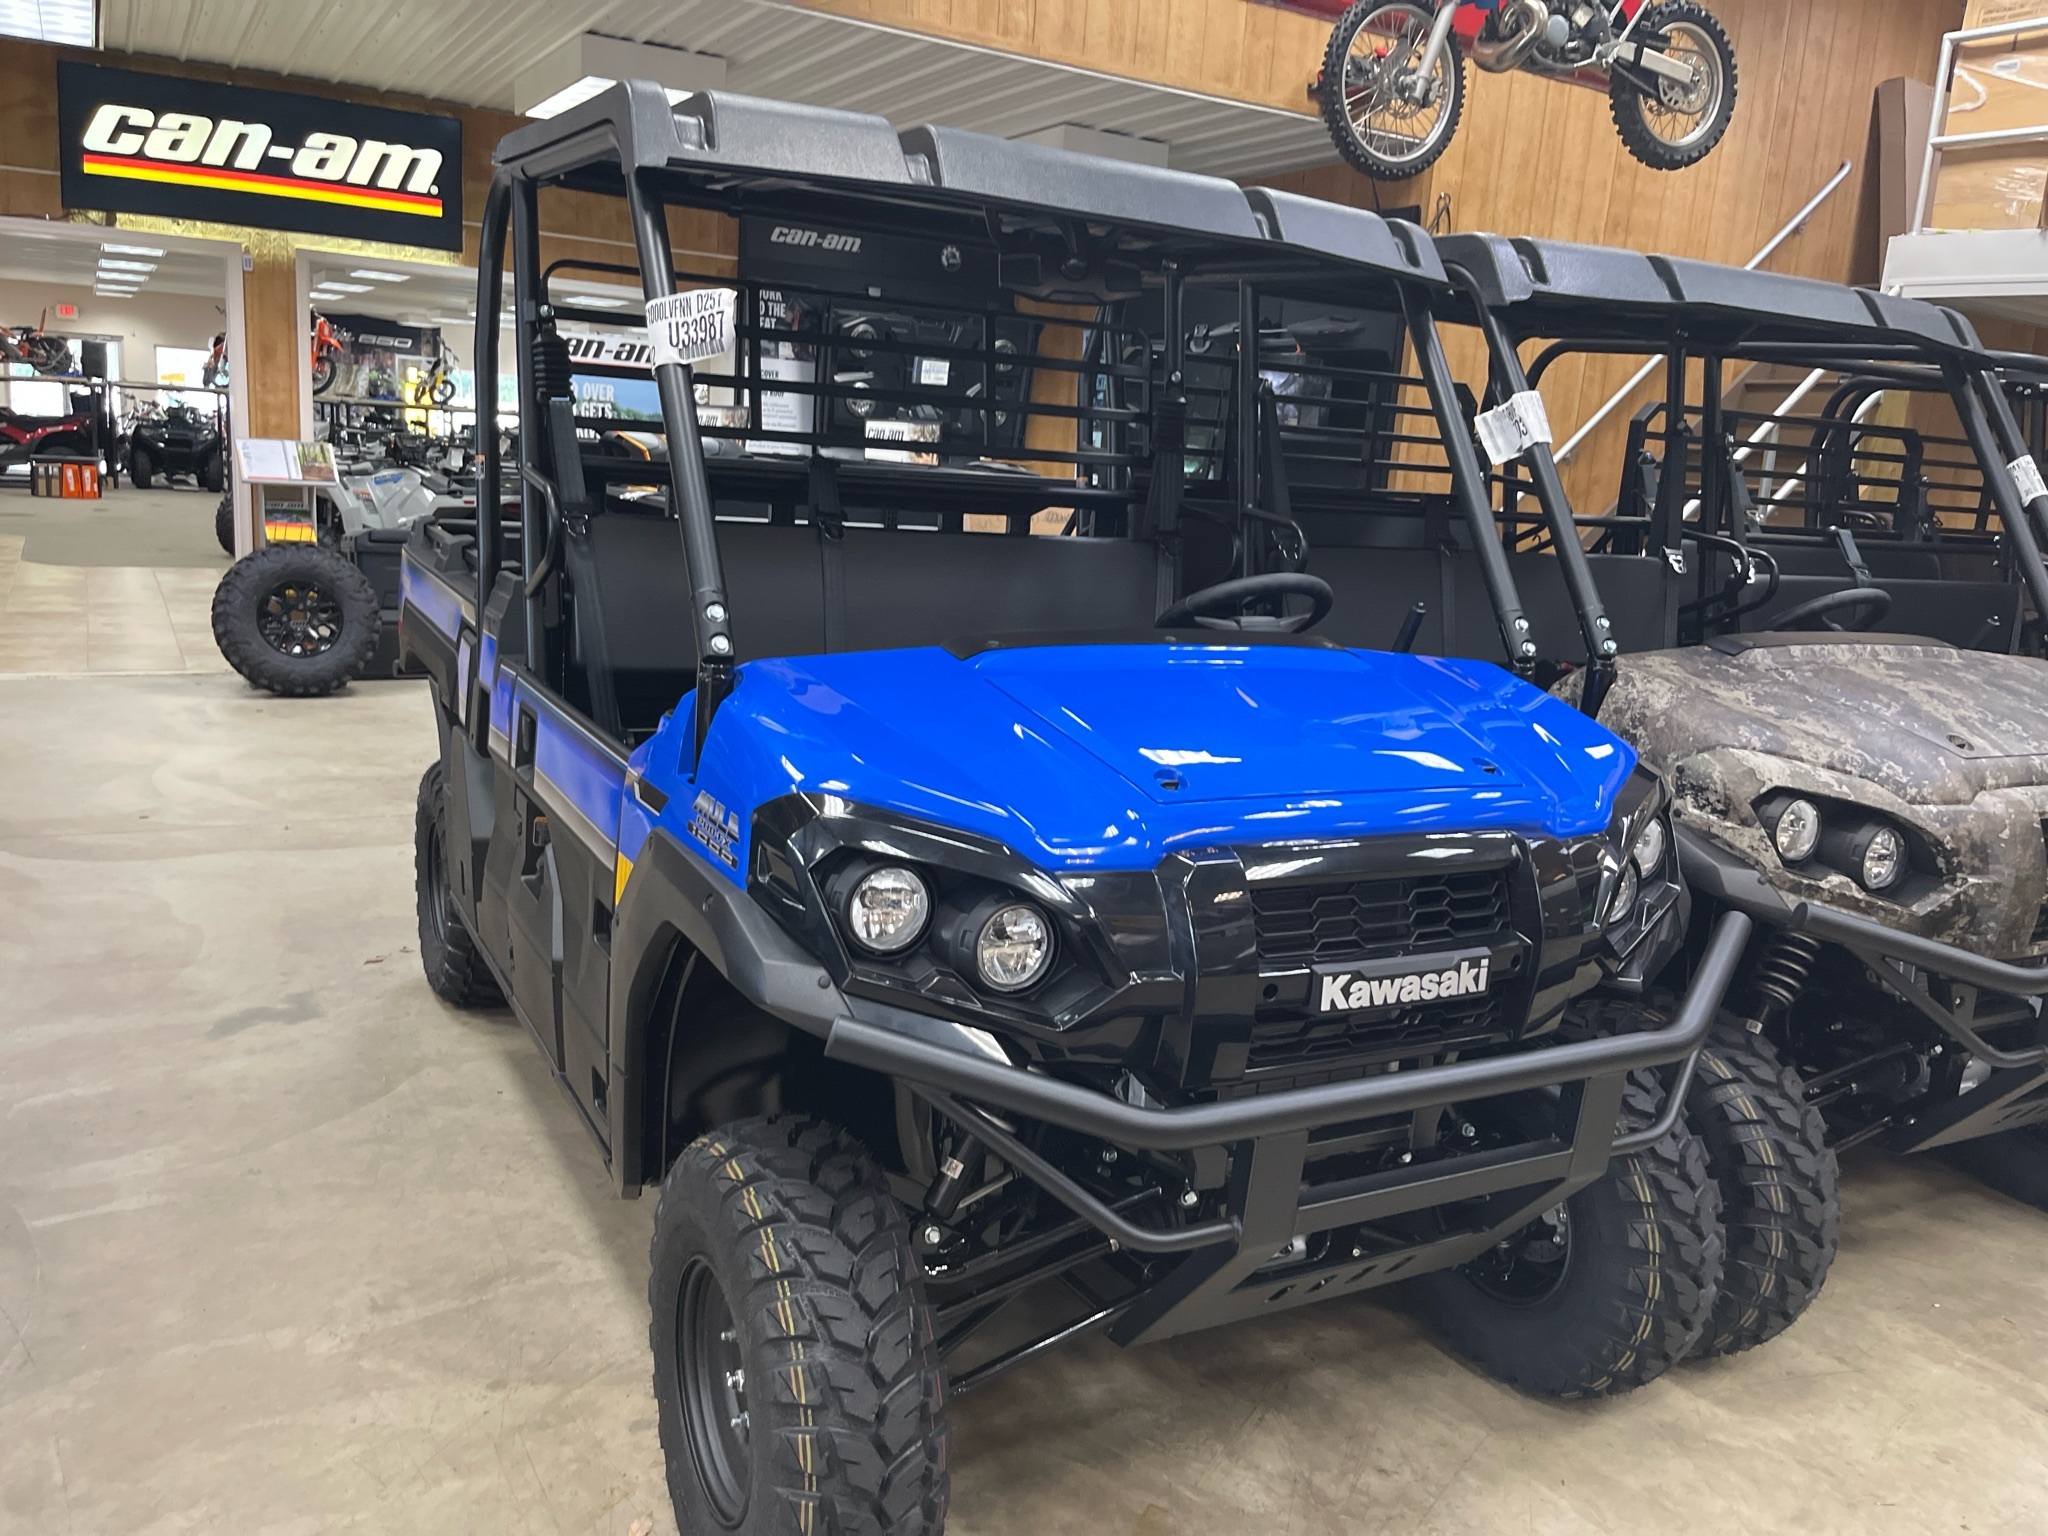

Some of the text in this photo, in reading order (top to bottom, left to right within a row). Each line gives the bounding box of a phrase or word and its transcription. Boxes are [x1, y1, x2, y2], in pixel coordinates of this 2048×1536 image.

[83, 104, 442, 194] can-am
[770, 226, 861, 253] can-am
[768, 301, 786, 318] THE
[668, 311, 724, 348] U33987
[567, 336, 651, 363] an-a
[761, 369, 779, 378] COVER
[582, 381, 615, 402] OVER
[1320, 958, 1489, 1012] Kawasaki
